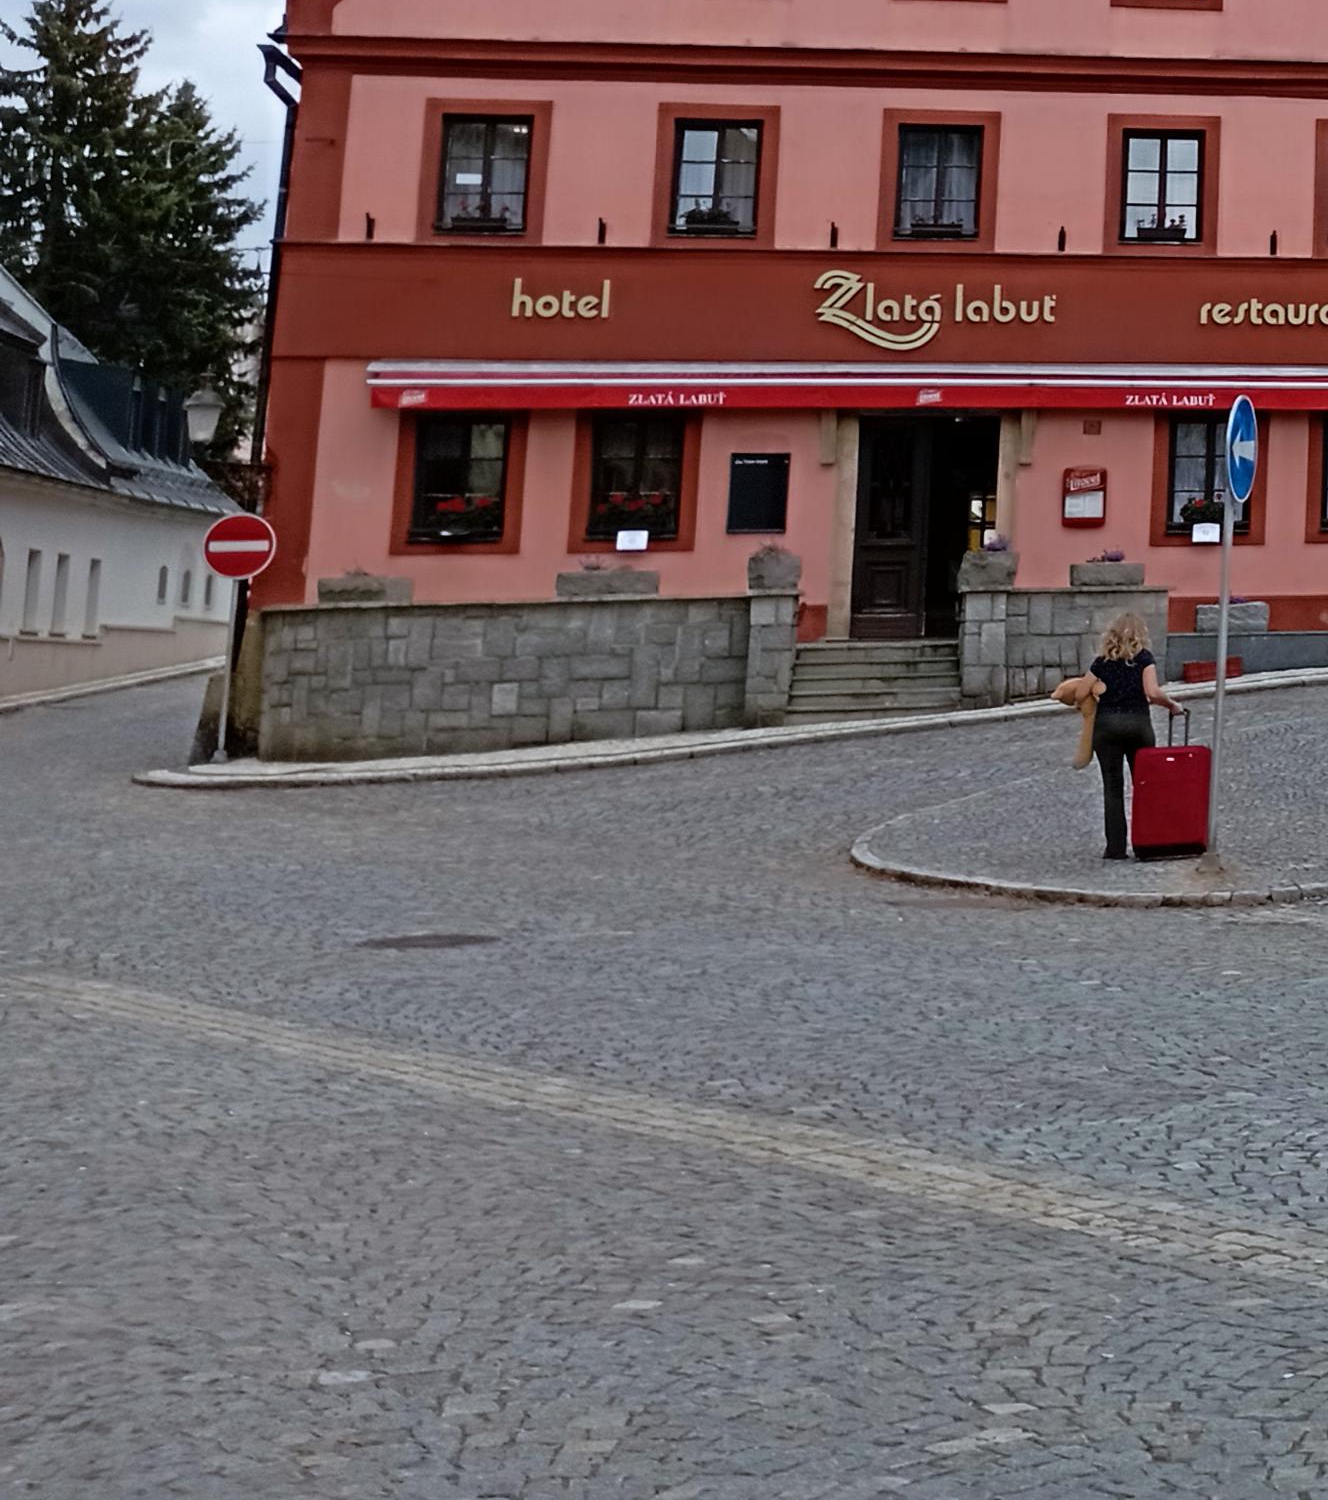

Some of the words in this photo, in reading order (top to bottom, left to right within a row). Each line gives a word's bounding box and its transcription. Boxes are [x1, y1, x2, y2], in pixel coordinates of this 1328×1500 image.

[511, 277, 611, 319] hotel
[814, 269, 942, 351] Zlatá
[955, 284, 1057, 323] labuť
[628, 391, 674, 405] ZLATÁ
[679, 391, 727, 405] LABUŤ
[1125, 392, 1168, 406] ZLATÁ
[1172, 393, 1216, 406] LABUŤ
